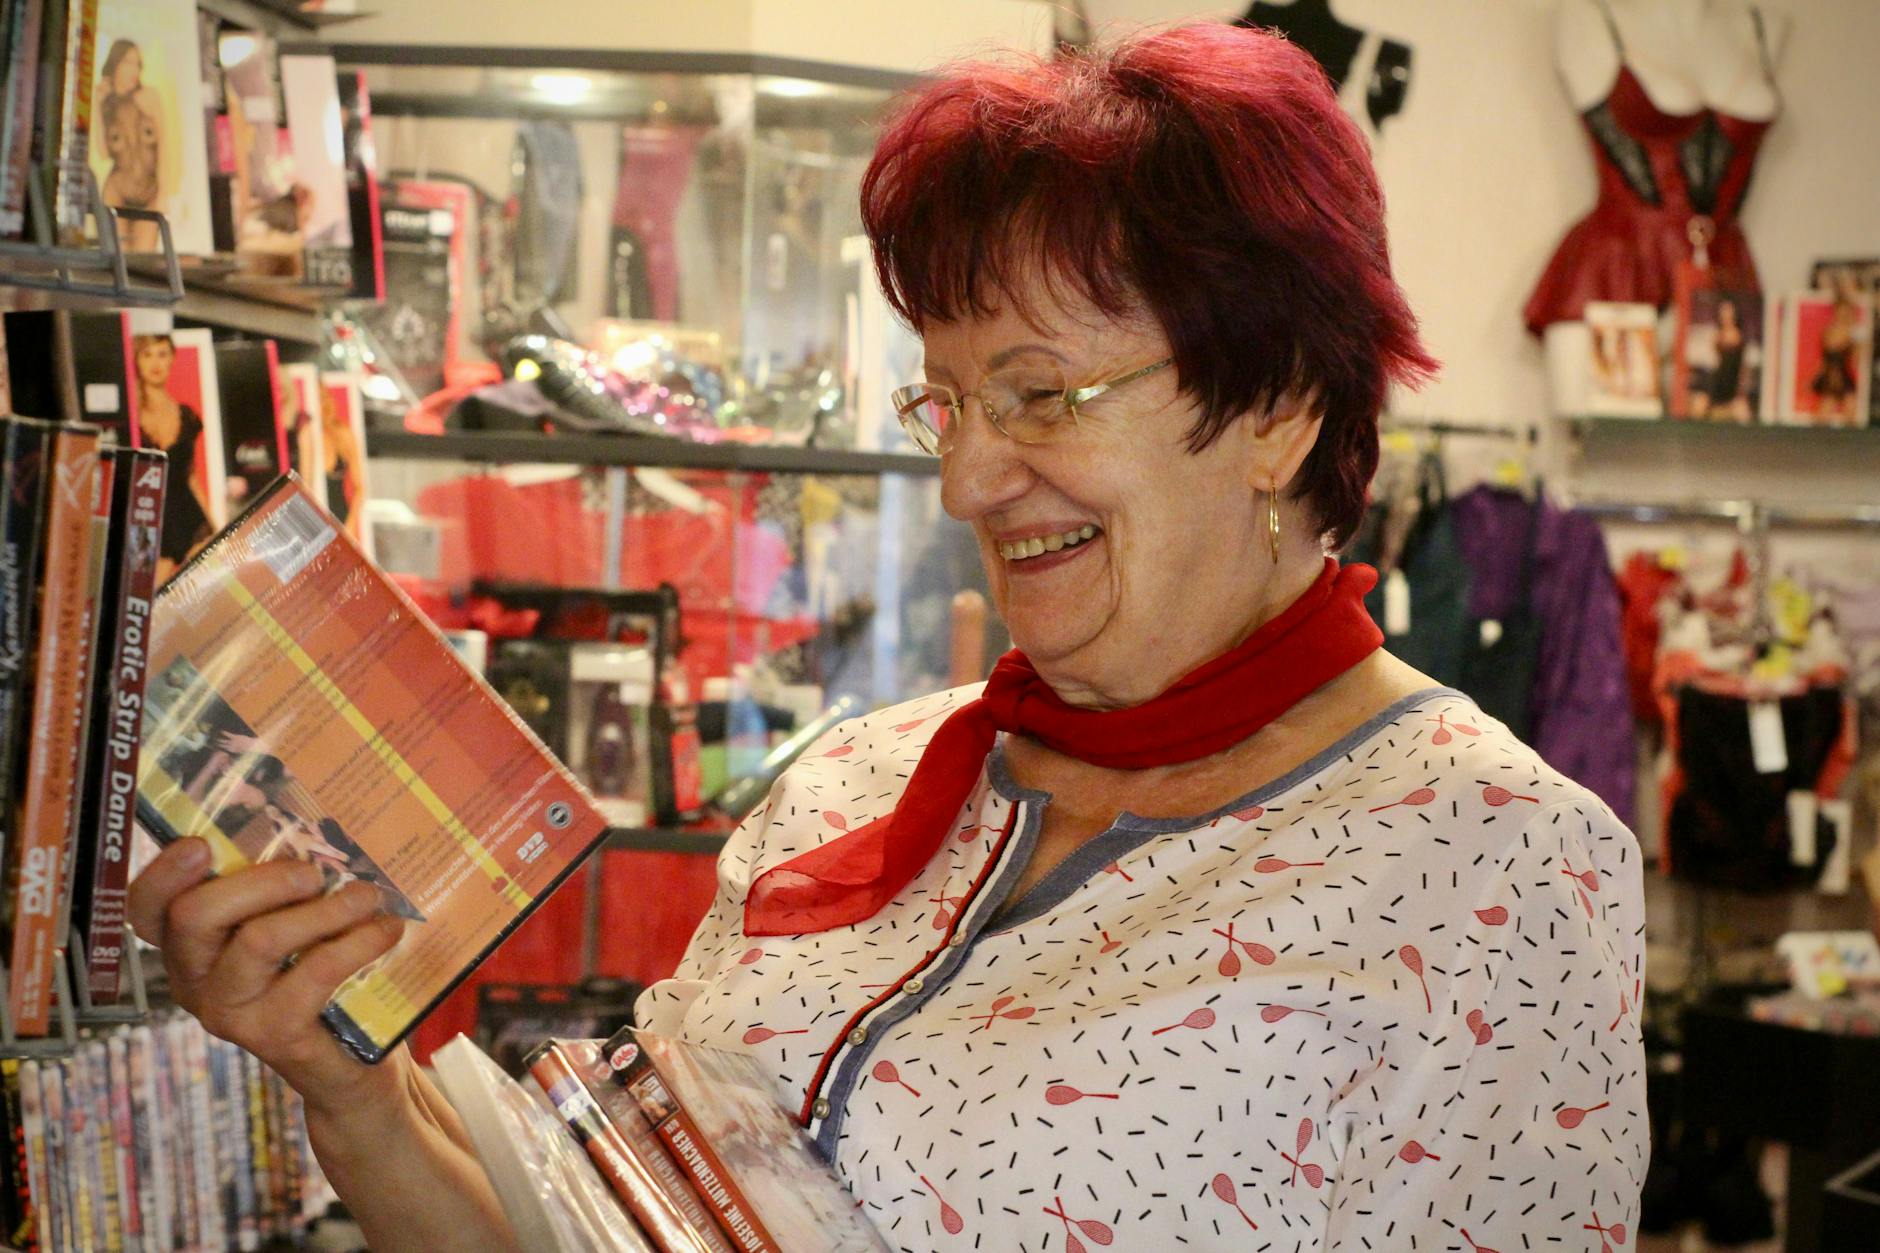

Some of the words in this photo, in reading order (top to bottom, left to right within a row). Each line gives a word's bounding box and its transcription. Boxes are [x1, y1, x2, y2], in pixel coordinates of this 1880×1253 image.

[119, 595, 149, 682] Erotic
[109, 689, 142, 762] Strip
[104, 771, 134, 864] Dance
[516, 832, 544, 861] DVD
[20, 847, 46, 916] DVD
[93, 946, 120, 957] DVD
[671, 1128, 732, 1210] MUTZENBACHER
[723, 1203, 764, 1253] JOSEFINE
